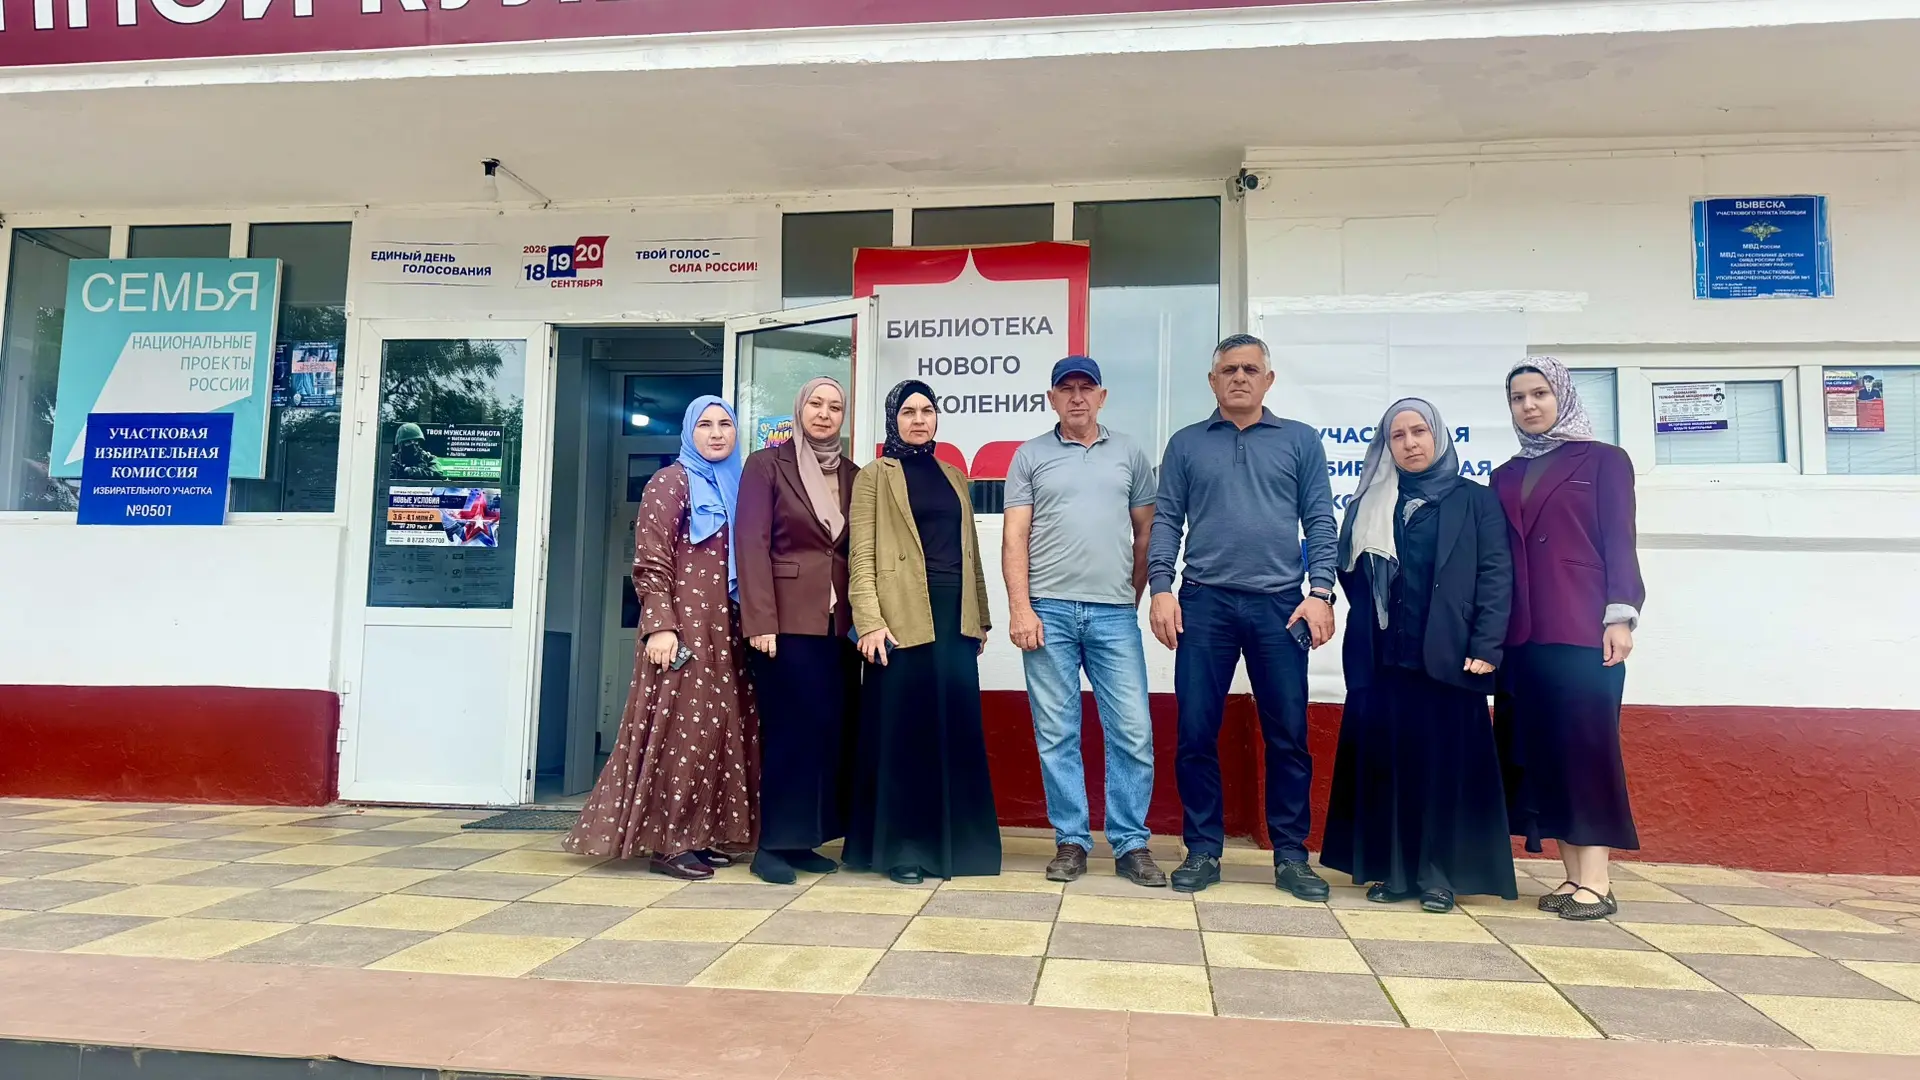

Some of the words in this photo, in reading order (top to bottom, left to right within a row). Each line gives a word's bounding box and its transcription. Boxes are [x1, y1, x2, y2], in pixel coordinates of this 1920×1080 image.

[1735, 201, 1786, 209] ВЫВЕСКА
[523, 245, 547, 254] 2026
[635, 248, 667, 260] ТВОЙ
[670, 249, 710, 259] ГОЛОС
[371, 251, 421, 261] ЕДИНЫЙ
[424, 253, 456, 263] ДЕНЬ
[524, 264, 545, 281] 18
[550, 253, 571, 271] 19
[575, 244, 601, 262] 20
[402, 264, 492, 276] ГОЛОСОВАНИЯ
[669, 263, 702, 273] СИЛА
[705, 262, 758, 272] РОССИИ!
[551, 279, 603, 288] СЕНТЯБРЯ
[82, 272, 260, 312] СЕМЬЯ
[886, 316, 1054, 339] БИБЛИОТЕКА
[132, 335, 253, 351] НАЦИОНАЛЬНЫЕ
[180, 356, 251, 370] ПРОЕКТЫ
[918, 355, 1021, 376] НОВОГО
[189, 377, 250, 391] РОССИИ
[936, 393, 1045, 414] КОЛЕНИЯ
[109, 427, 208, 439] УЧАСТКОВАЯ
[94, 447, 219, 459] ИЗБИРАТЕЛЬНАЯ
[111, 466, 198, 478] КОМИССИЯ
[93, 486, 171, 495] ИЗБИРАТЕЛЬНОГО
[172, 486, 213, 495] УЧАСТКА
[393, 496, 413, 504] НОВЫЕ
[414, 496, 440, 504] УСЛОВИЯ
[126, 504, 172, 517] №0501
